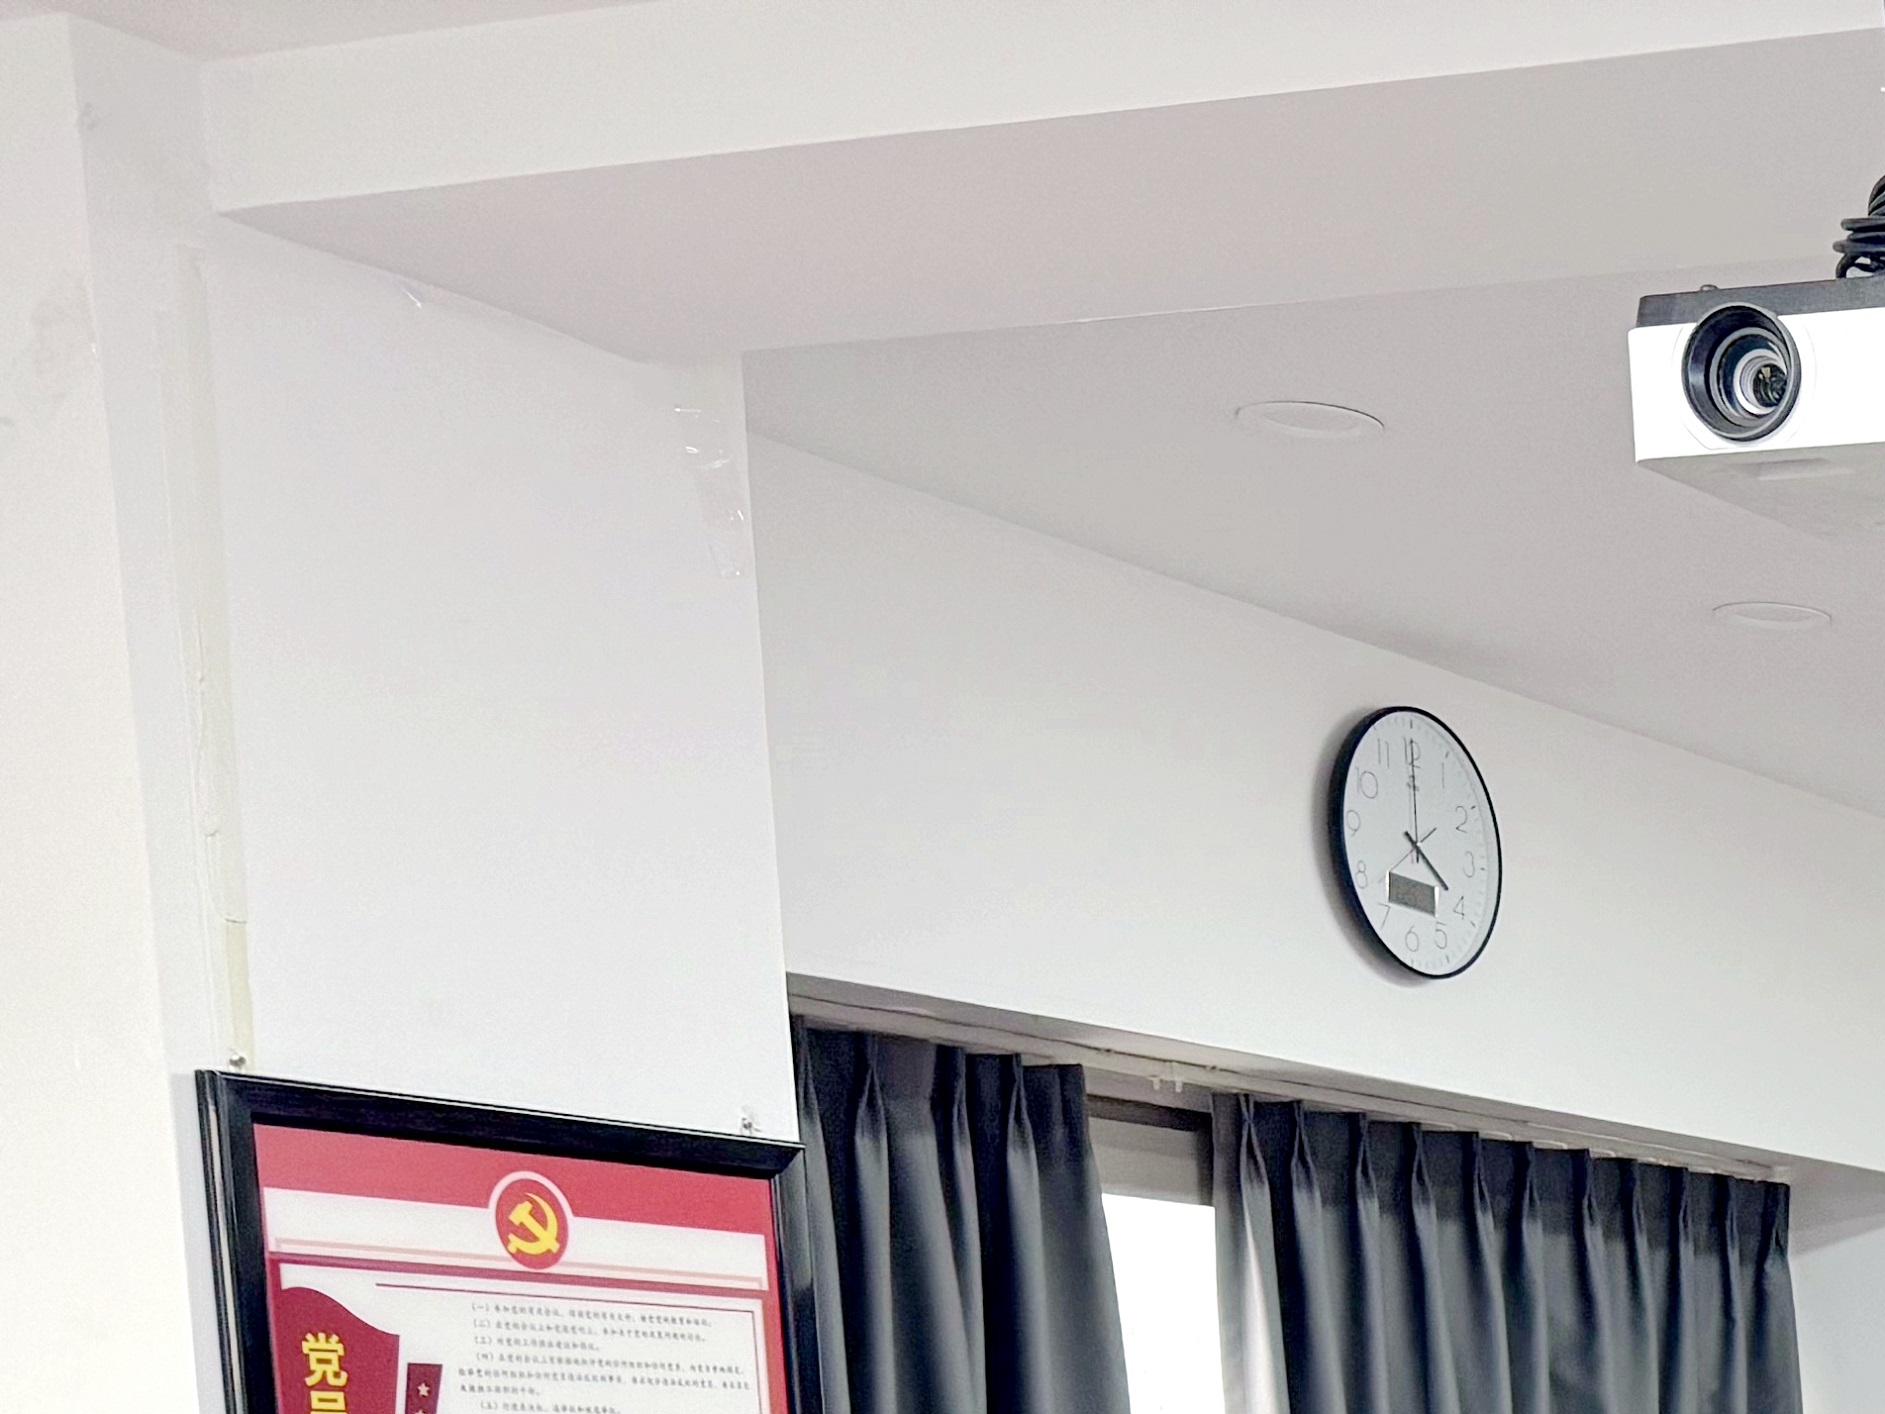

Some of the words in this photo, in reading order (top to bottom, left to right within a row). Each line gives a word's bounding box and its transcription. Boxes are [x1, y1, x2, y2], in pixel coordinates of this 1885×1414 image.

[1355, 767, 1379, 800] 10
[1346, 810, 1361, 837] 9
[1455, 806, 1468, 833] 2
[1355, 861, 1369, 890] 8
[1465, 852, 1476, 879] 3
[1379, 903, 1391, 931] 7
[1452, 895, 1466, 921] 4
[1404, 926, 1421, 954] 6
[1434, 924, 1449, 951] 5
